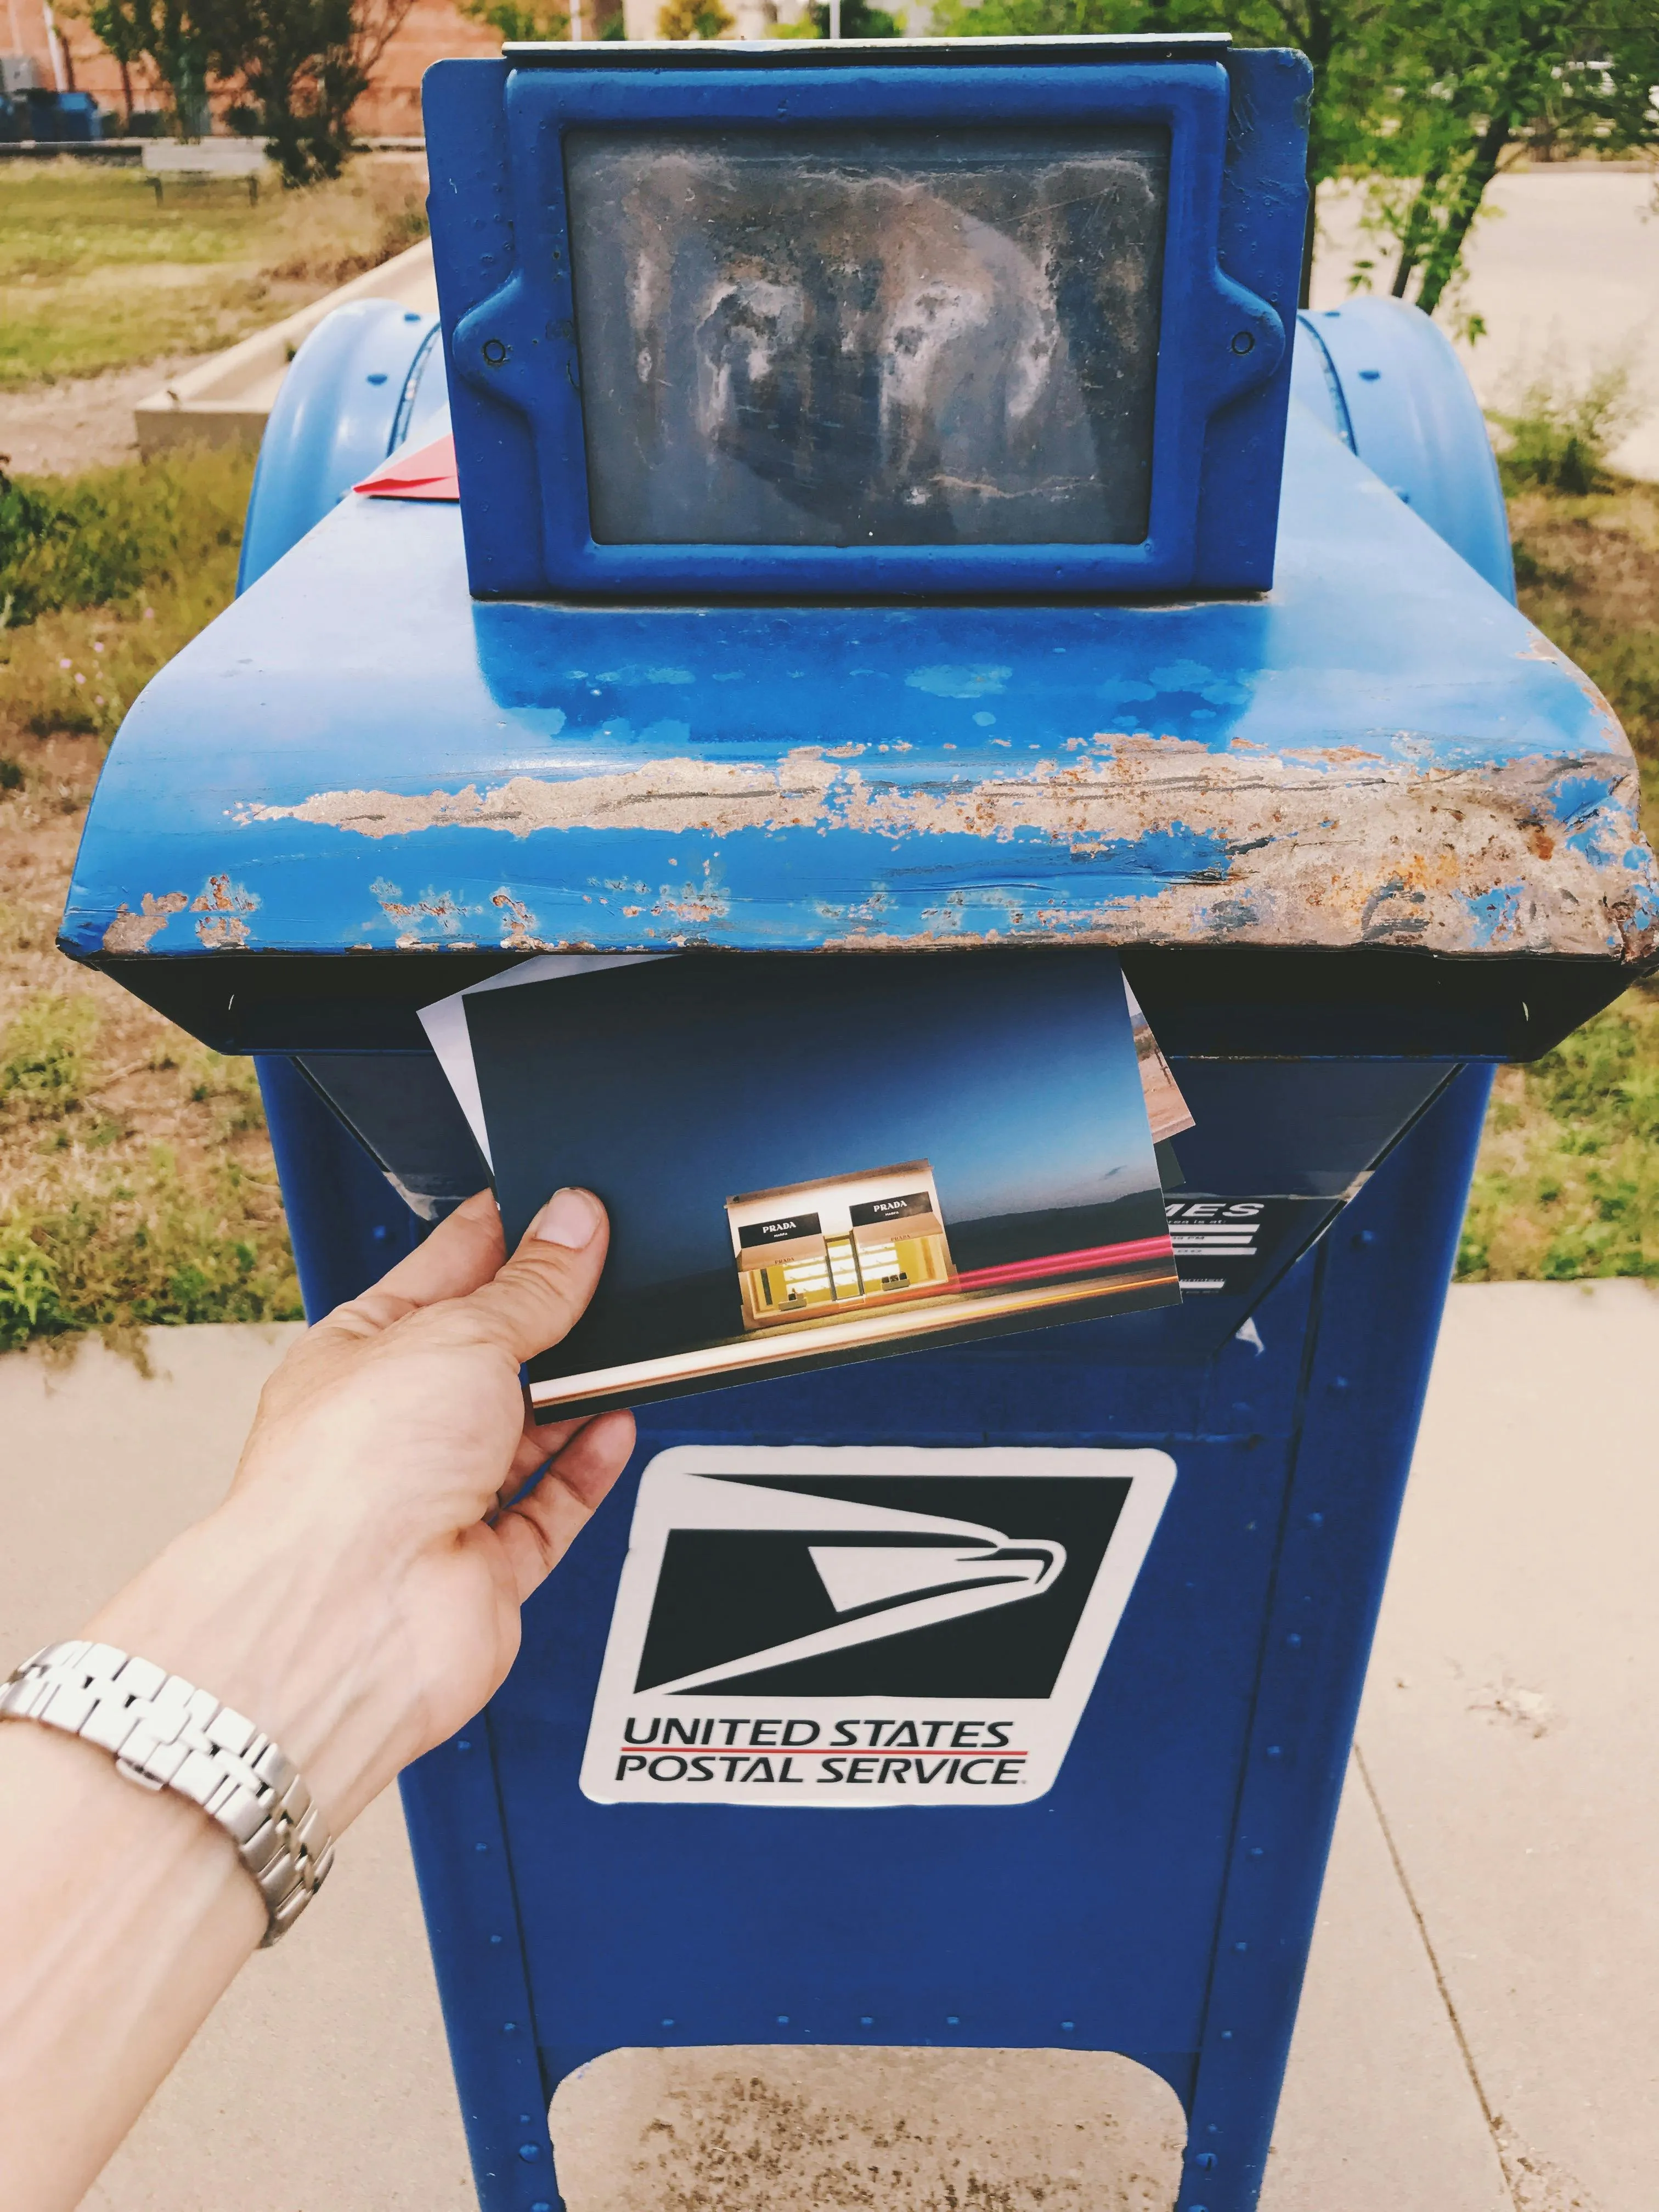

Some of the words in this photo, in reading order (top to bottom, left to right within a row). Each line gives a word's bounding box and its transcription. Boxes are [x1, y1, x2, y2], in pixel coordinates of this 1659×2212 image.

[873, 1200, 907, 1212] PRADA
[763, 1221, 797, 1233] PRADA
[623, 1717, 820, 1746] UNITED
[830, 1719, 1013, 1748] STATES
[615, 1755, 803, 1783] POSTAL
[816, 1758, 1026, 1785] SERVICE
